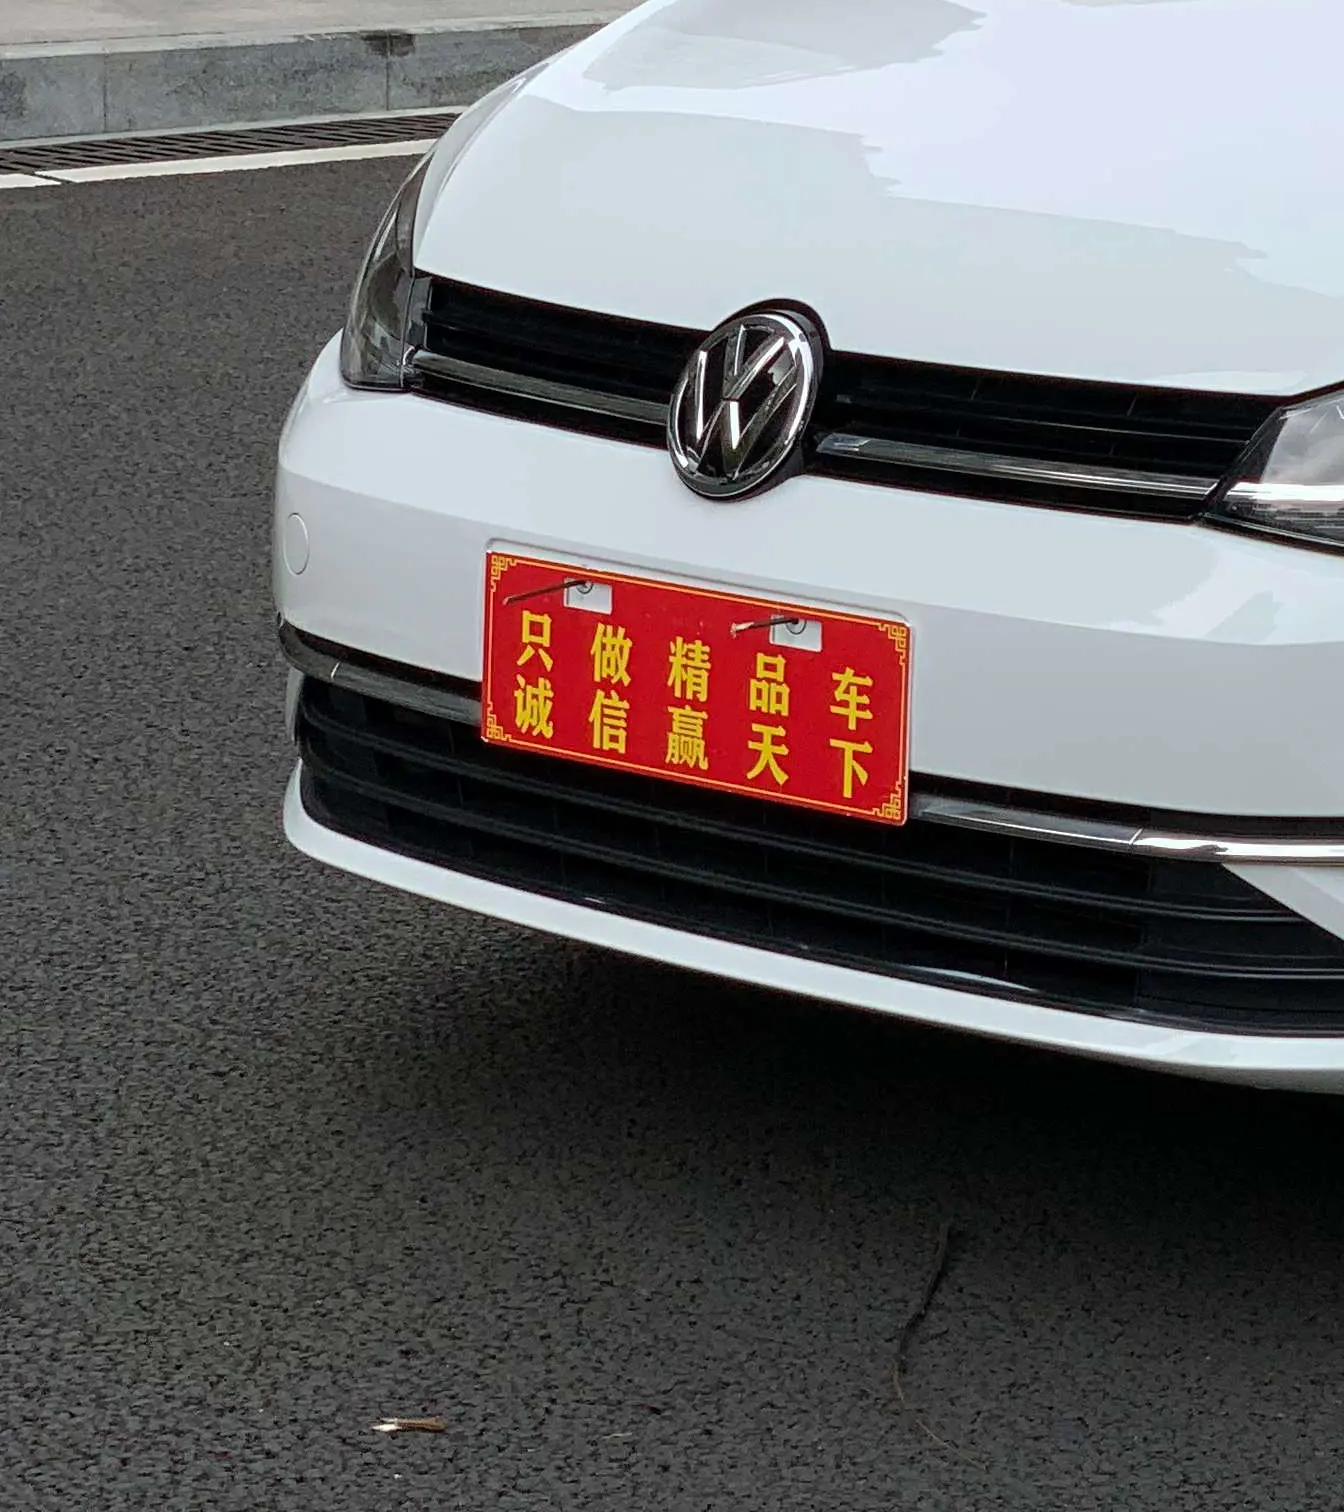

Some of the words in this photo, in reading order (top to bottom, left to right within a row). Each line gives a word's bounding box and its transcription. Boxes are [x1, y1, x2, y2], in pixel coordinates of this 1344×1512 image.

[516, 609, 874, 731] 只做精品车
[513, 676, 873, 799] 诚信赢天下
